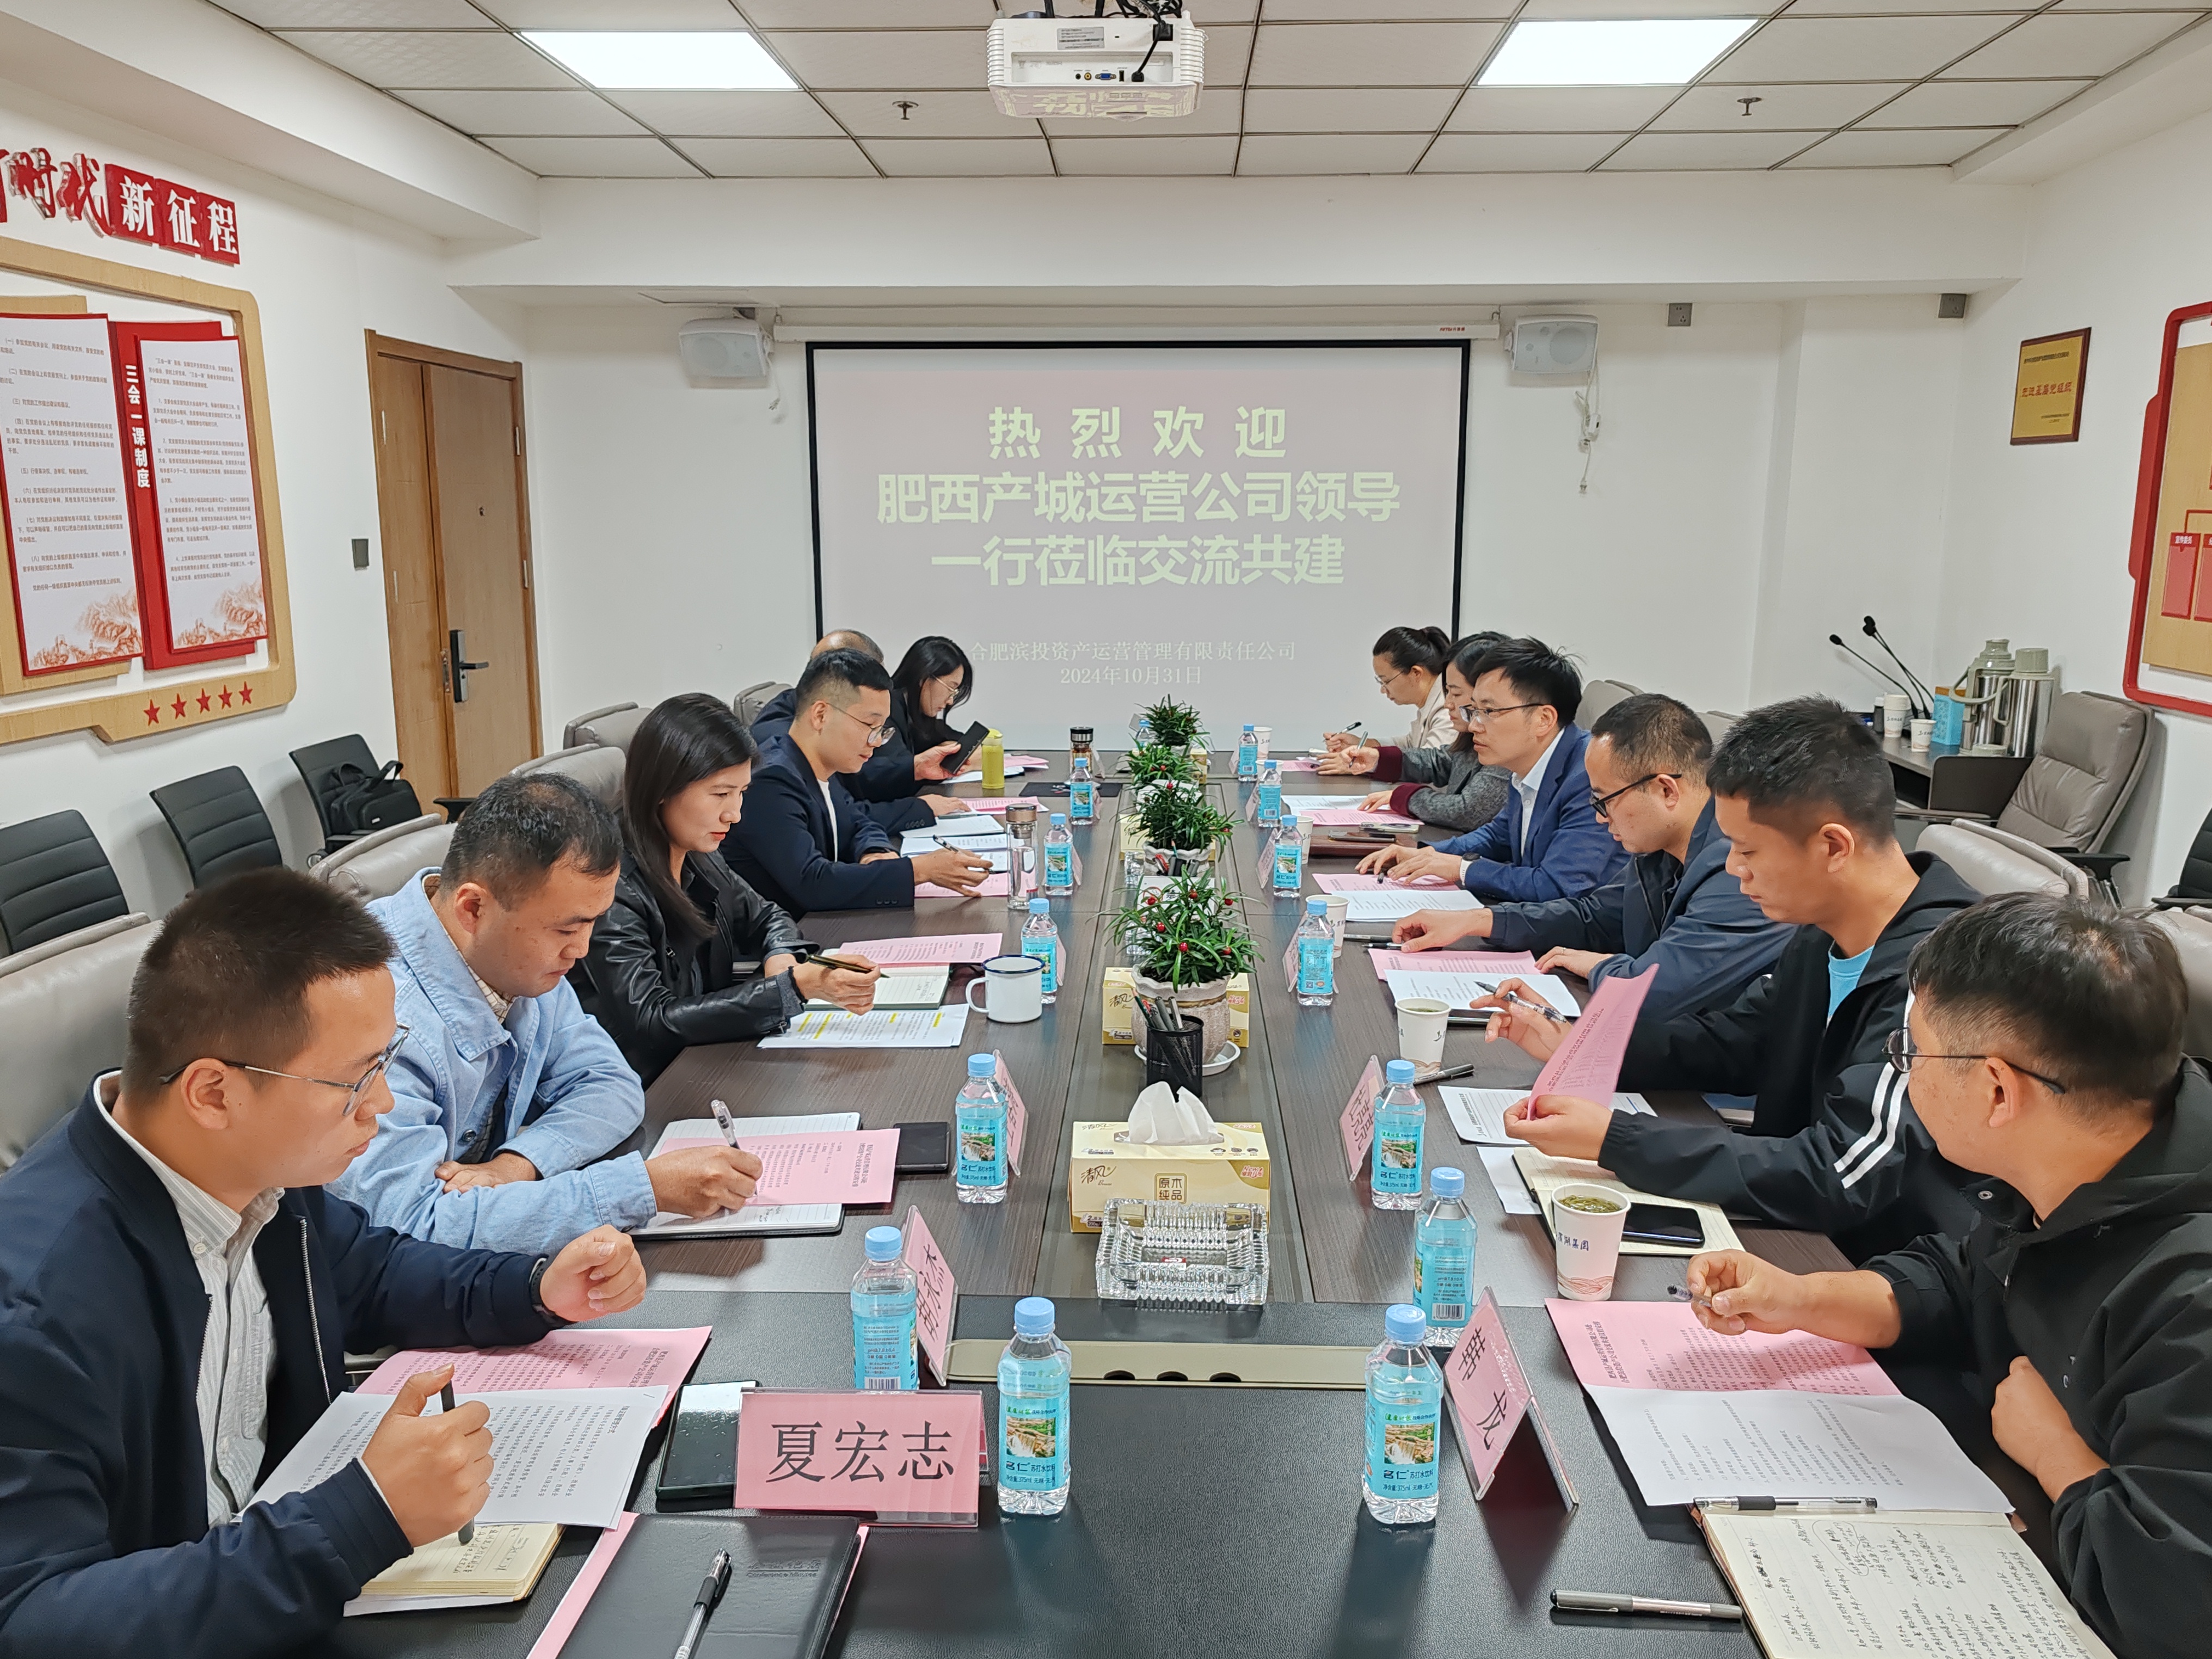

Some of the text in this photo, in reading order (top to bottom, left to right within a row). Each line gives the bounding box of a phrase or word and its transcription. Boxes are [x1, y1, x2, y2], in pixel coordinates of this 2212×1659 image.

[125, 364, 151, 489] 三会一课制度
[877, 471, 1400, 524] 肥西产城运营公司领导
[931, 534, 1344, 586] 一行莅临交流共建
[970, 641, 1296, 662] 合肥滨投资产运营管理有限责任公司
[1060, 666, 1202, 686] 2024年10月31日
[1159, 1177, 1183, 1189] 原木
[1159, 1190, 1183, 1201] 纯品
[1477, 1390, 1507, 1451] 龙
[766, 1421, 954, 1483] 夏宏志
[1006, 1461, 1028, 1471] 名仁
[1384, 1468, 1433, 1479] 名仁 苏打水饮料
